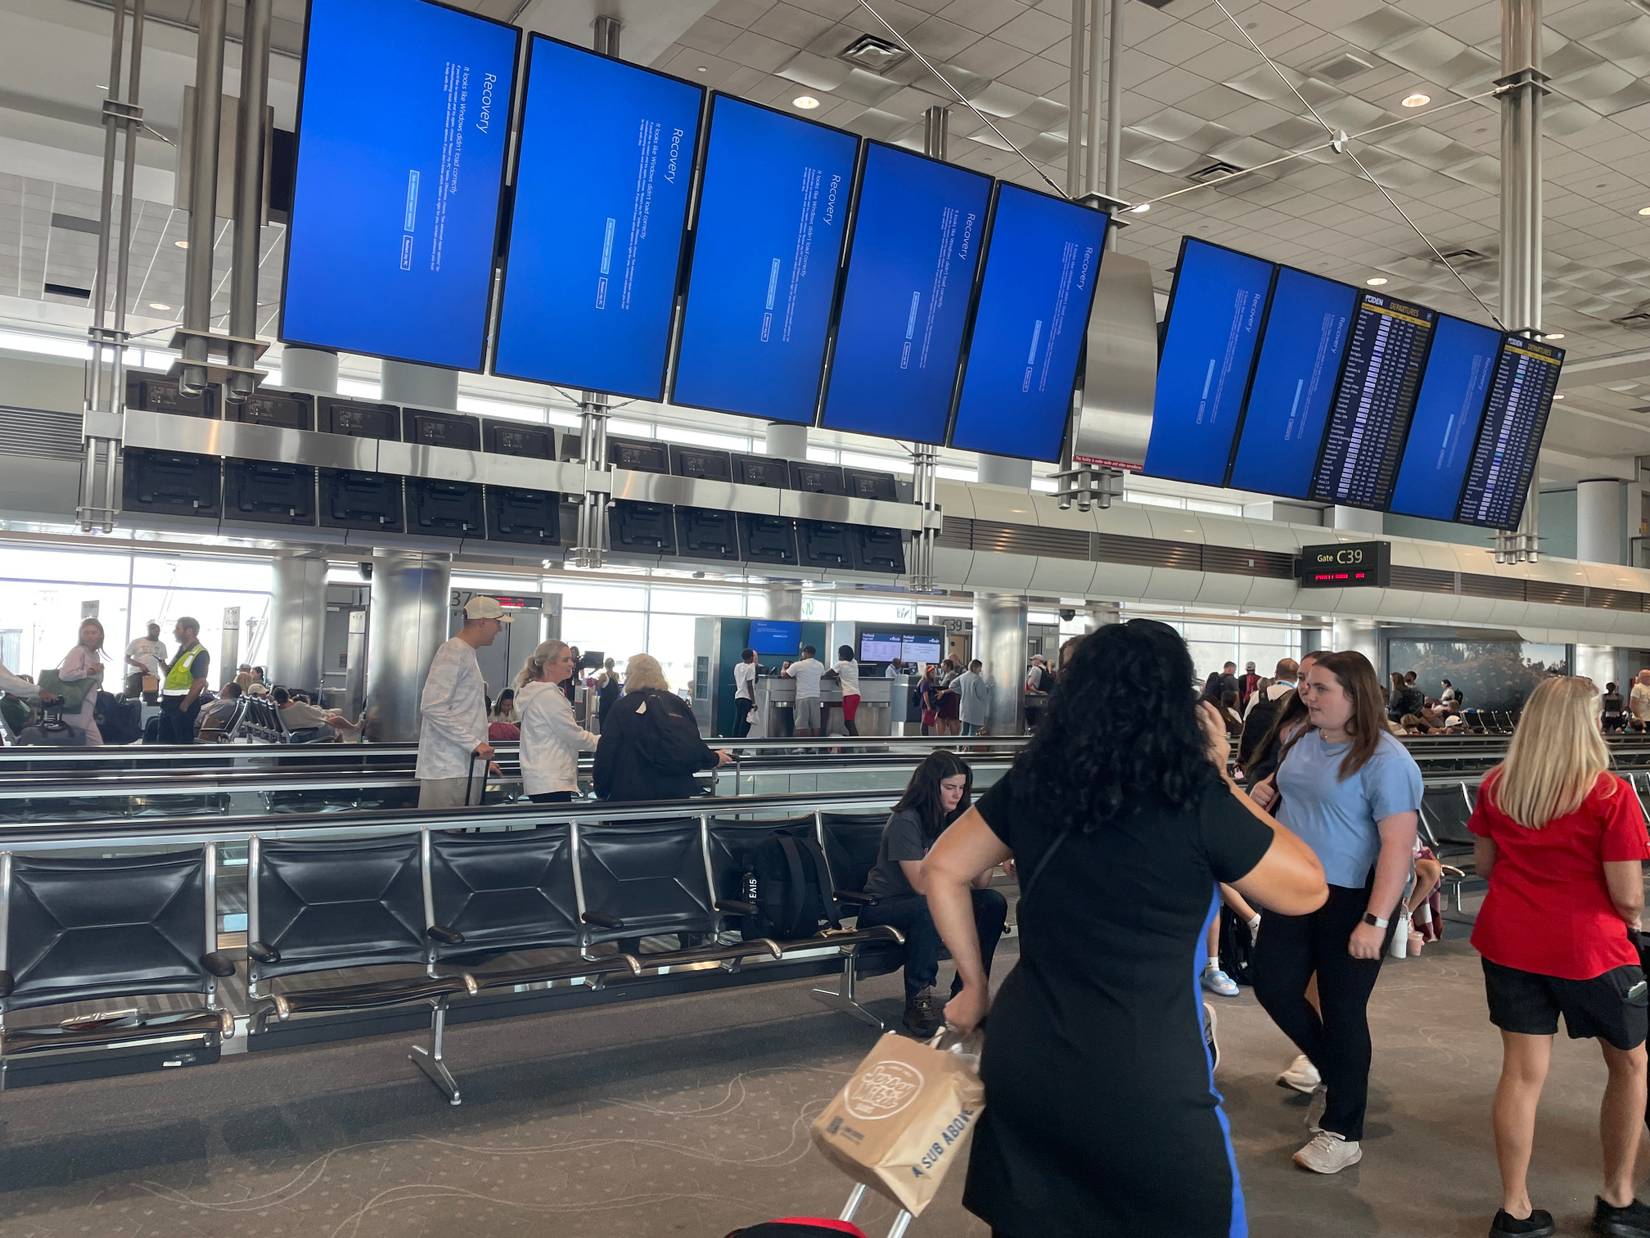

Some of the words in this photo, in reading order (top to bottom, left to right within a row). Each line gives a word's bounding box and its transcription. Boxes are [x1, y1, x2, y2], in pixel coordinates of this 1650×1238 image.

[460, 91, 468, 102] like
[462, 73, 470, 90] looks
[457, 103, 467, 132] Windows
[476, 73, 497, 134] Recovery
[649, 157, 657, 182] Windows
[664, 128, 684, 183] Recovery
[450, 168, 459, 195] correctly
[823, 175, 841, 225] Recovery
[959, 213, 976, 260] Recovery
[1077, 247, 1093, 291] Recovery
[1247, 293, 1261, 332] Recovery
[1317, 554, 1334, 563] Gate
[1336, 549, 1363, 564] C39
[911, 1166, 923, 1178] A
[921, 1142, 945, 1169] SUB
